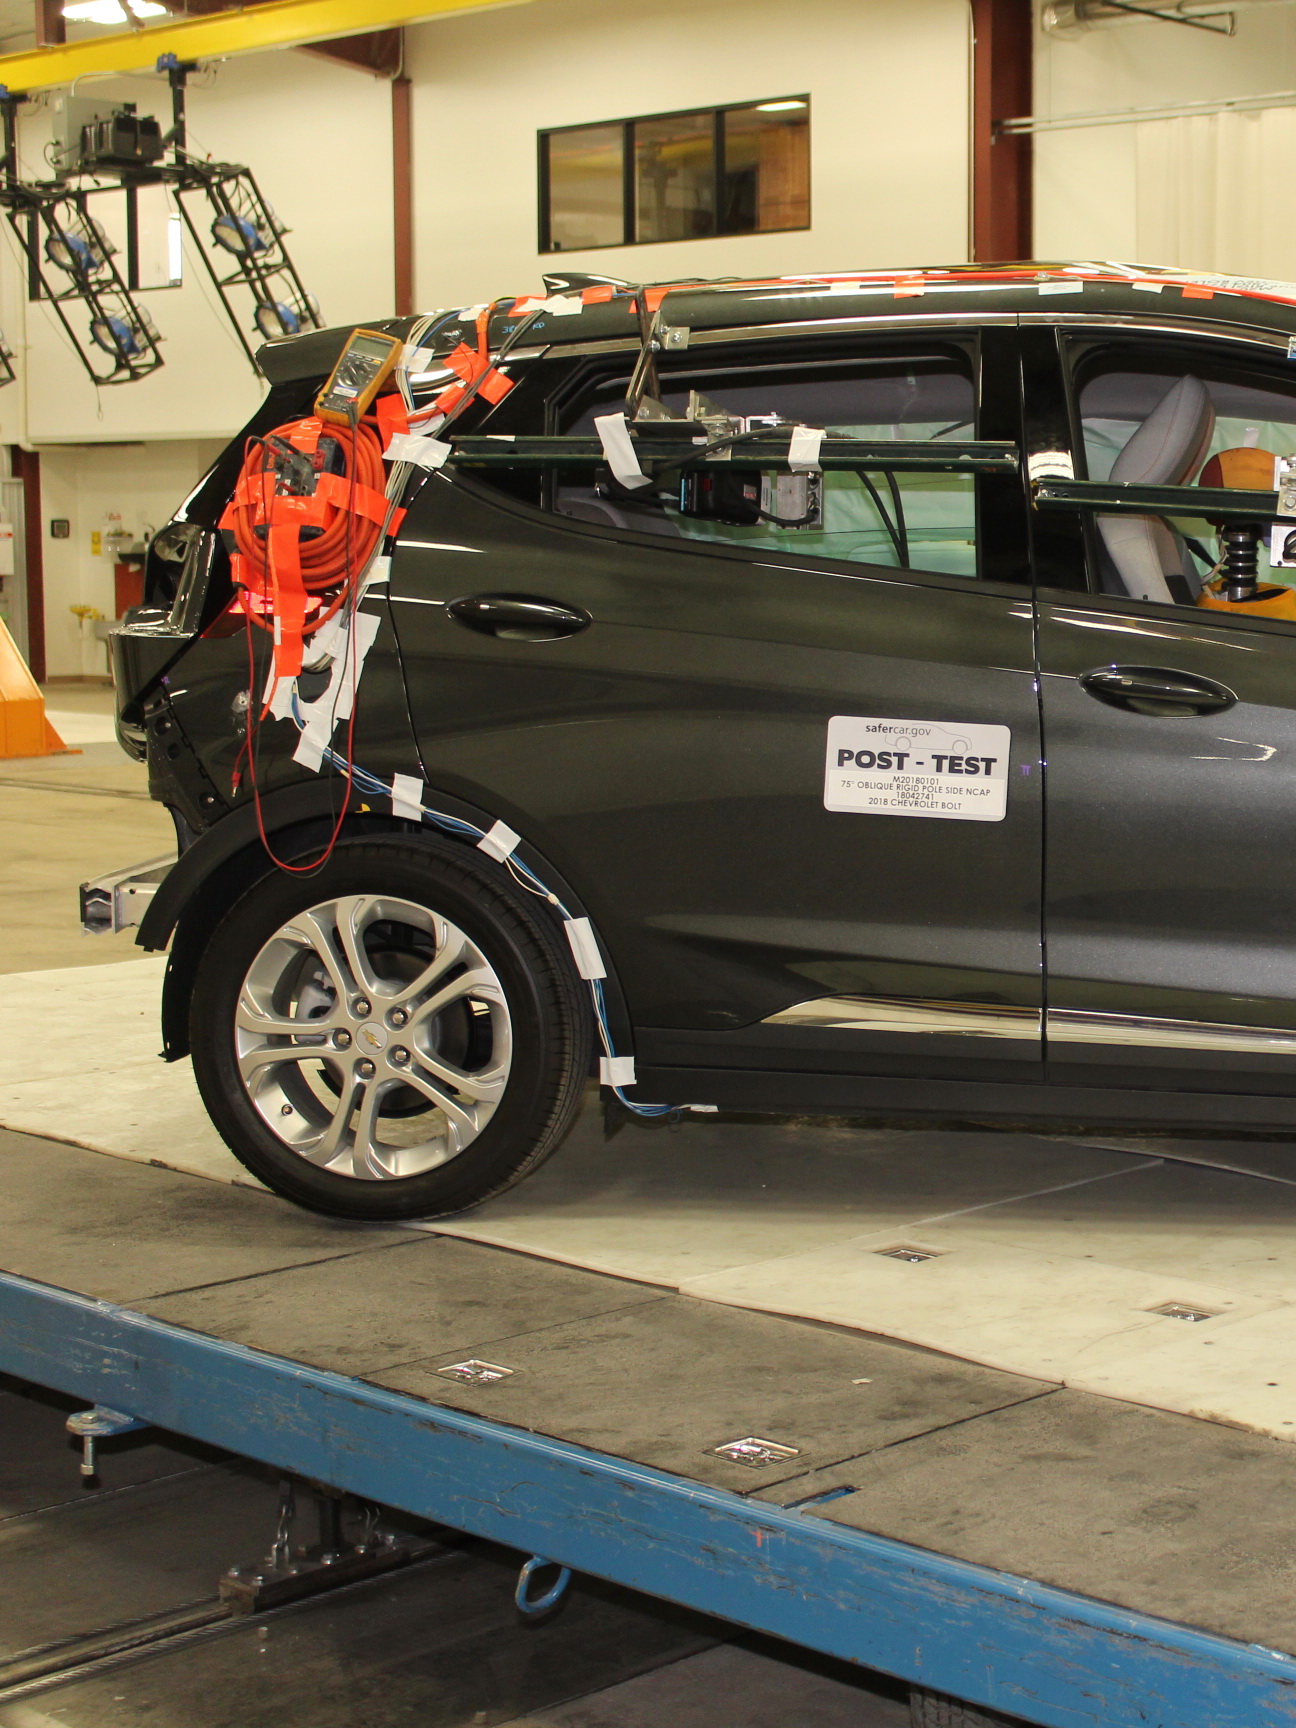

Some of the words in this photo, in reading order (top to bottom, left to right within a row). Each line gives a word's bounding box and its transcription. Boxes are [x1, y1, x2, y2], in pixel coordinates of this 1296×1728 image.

[865, 723, 932, 737] safercar.gov
[837, 749, 910, 771] POST
[931, 754, 997, 776] TEST
[892, 776, 939, 785] M20180101
[857, 781, 894, 791] OBLIQUE
[896, 783, 920, 792] RIGID
[922, 785, 943, 794] POLE
[945, 786, 964, 795] SIDE
[965, 787, 991, 797] NCAP
[896, 791, 935, 801] 18042741
[868, 797, 889, 807] 2018
[890, 799, 939, 809] CHEVROLET
[941, 801, 962, 811] BOLT
